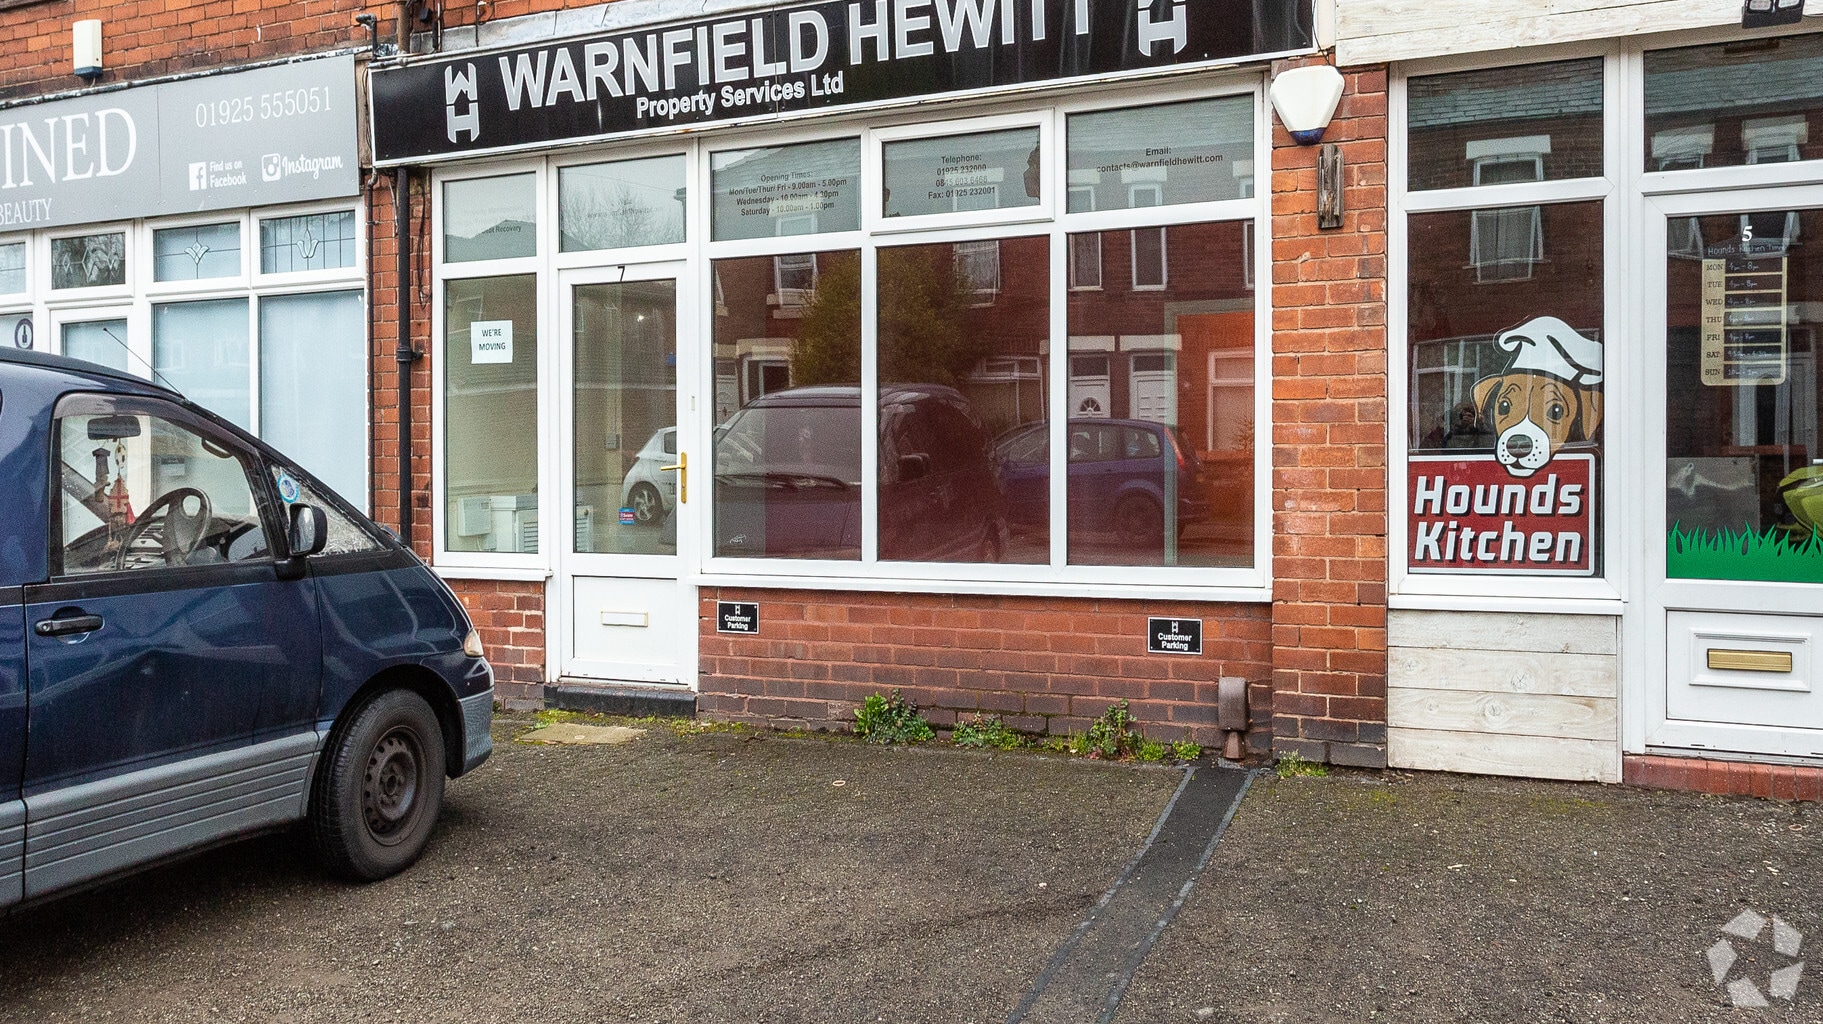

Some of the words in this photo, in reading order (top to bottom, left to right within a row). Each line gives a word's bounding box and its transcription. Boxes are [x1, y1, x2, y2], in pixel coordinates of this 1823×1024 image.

[499, 9, 829, 111] WARNFIELD
[636, 88, 717, 120] Property
[720, 81, 806, 108] Services
[811, 71, 845, 96] Ltd
[195, 96, 254, 128] 01925
[260, 86, 332, 120] 555051
[0, 107, 137, 189] INED
[1145, 146, 1172, 156] Email:
[941, 154, 982, 164] Telephone:
[1096, 154, 1223, 173] contacts@warnfieldhewitt.com
[209, 161, 223, 172] Find
[225, 162, 233, 171] us
[234, 160, 243, 170] on
[282, 154, 343, 180] Instagram
[936, 167, 959, 176] 01925
[960, 164, 987, 174] 232000
[210, 172, 247, 188] Facebook
[760, 172, 789, 183] Opening
[777, 183, 787, 192] Fri
[792, 181, 816, 190] 9.00am
[822, 178, 847, 188] 5.00pm
[928, 190, 944, 199] Fax:
[945, 188, 968, 198] 01925
[969, 186, 996, 196] 232001
[736, 196, 775, 206] Wednesday
[741, 206, 771, 216] Saturday
[776, 204, 804, 213] 10.00am
[495, 225, 521, 233] Recovery
[1741, 225, 1753, 242] 5
[1706, 263, 1723, 271] MON
[617, 265, 625, 282] 7
[481, 328, 502, 337] WE'RE
[478, 342, 506, 351] MOVING
[1414, 474, 1583, 516] Hounds
[1414, 521, 1583, 564] Kitchen
[724, 614, 751, 623] Customer
[727, 622, 749, 631] Parking
[1158, 632, 1192, 642] Customer
[1161, 640, 1189, 651] Parking
